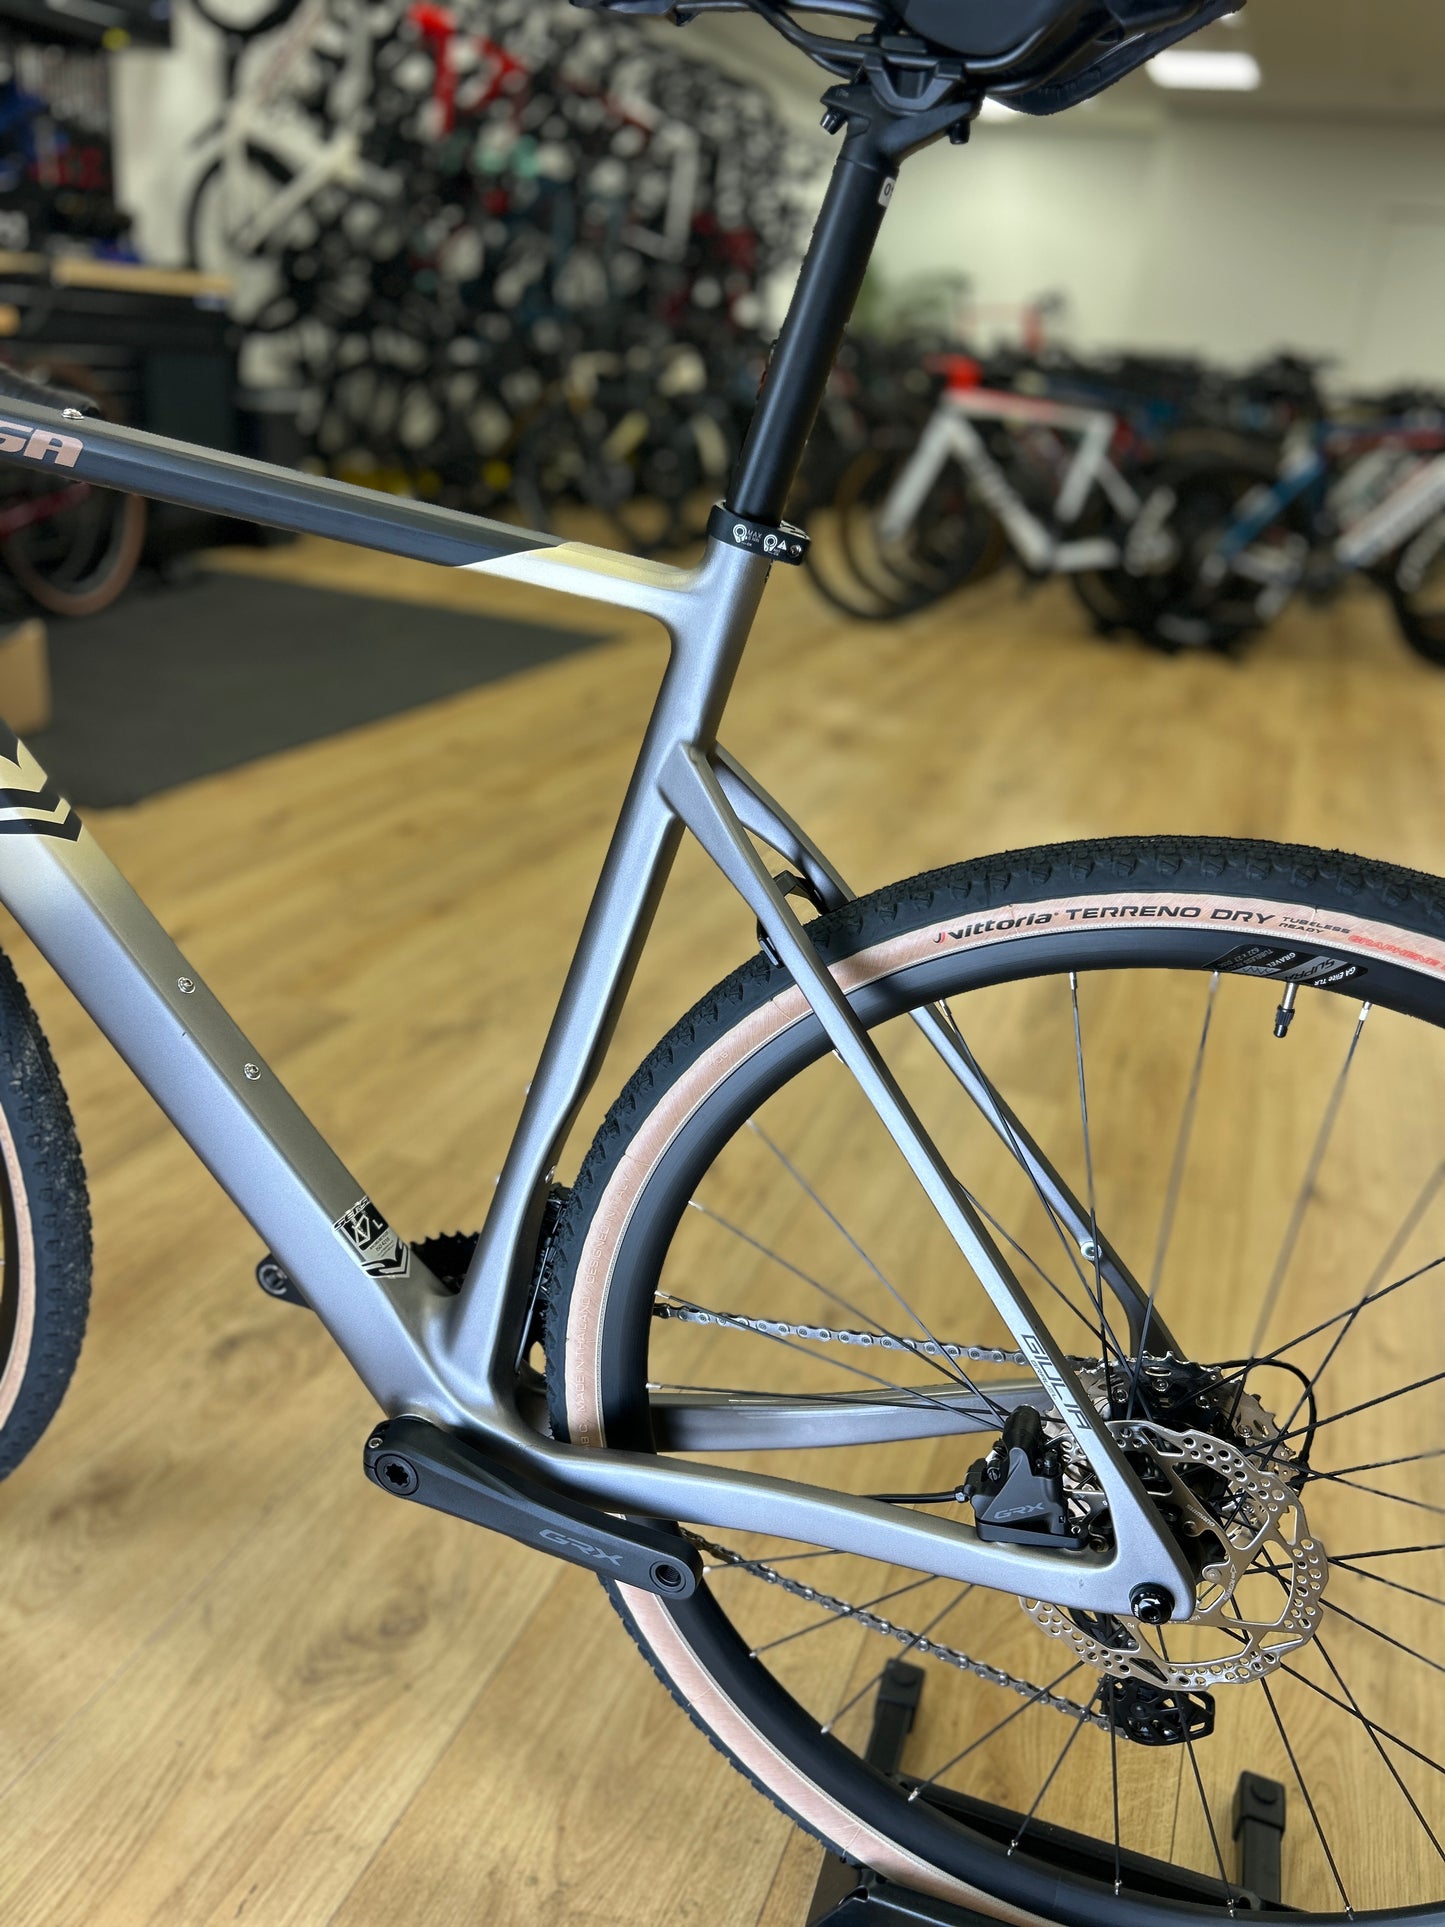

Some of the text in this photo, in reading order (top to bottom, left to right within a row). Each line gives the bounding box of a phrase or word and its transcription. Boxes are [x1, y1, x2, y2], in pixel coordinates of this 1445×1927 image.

[1065, 905, 1202, 921] TERRENO
[1209, 908, 1276, 925] DRY
[1278, 922, 1325, 934] READY
[1282, 916, 1352, 934] TUBELESS
[1265, 951, 1296, 968] GRAVEL
[1284, 958, 1336, 980] SUPRA
[1328, 972, 1344, 982] Elite
[1314, 978, 1327, 986] TLR
[372, 1219, 383, 1230] L
[585, 1225, 610, 1284] DESIGNED
[575, 1296, 592, 1358] THAILAND
[575, 1359, 587, 1373] IN
[1020, 1334, 1092, 1429] GIULIA
[575, 1374, 587, 1412] MADE
[993, 1502, 1045, 1520] GRX
[538, 1528, 624, 1567] GRX
